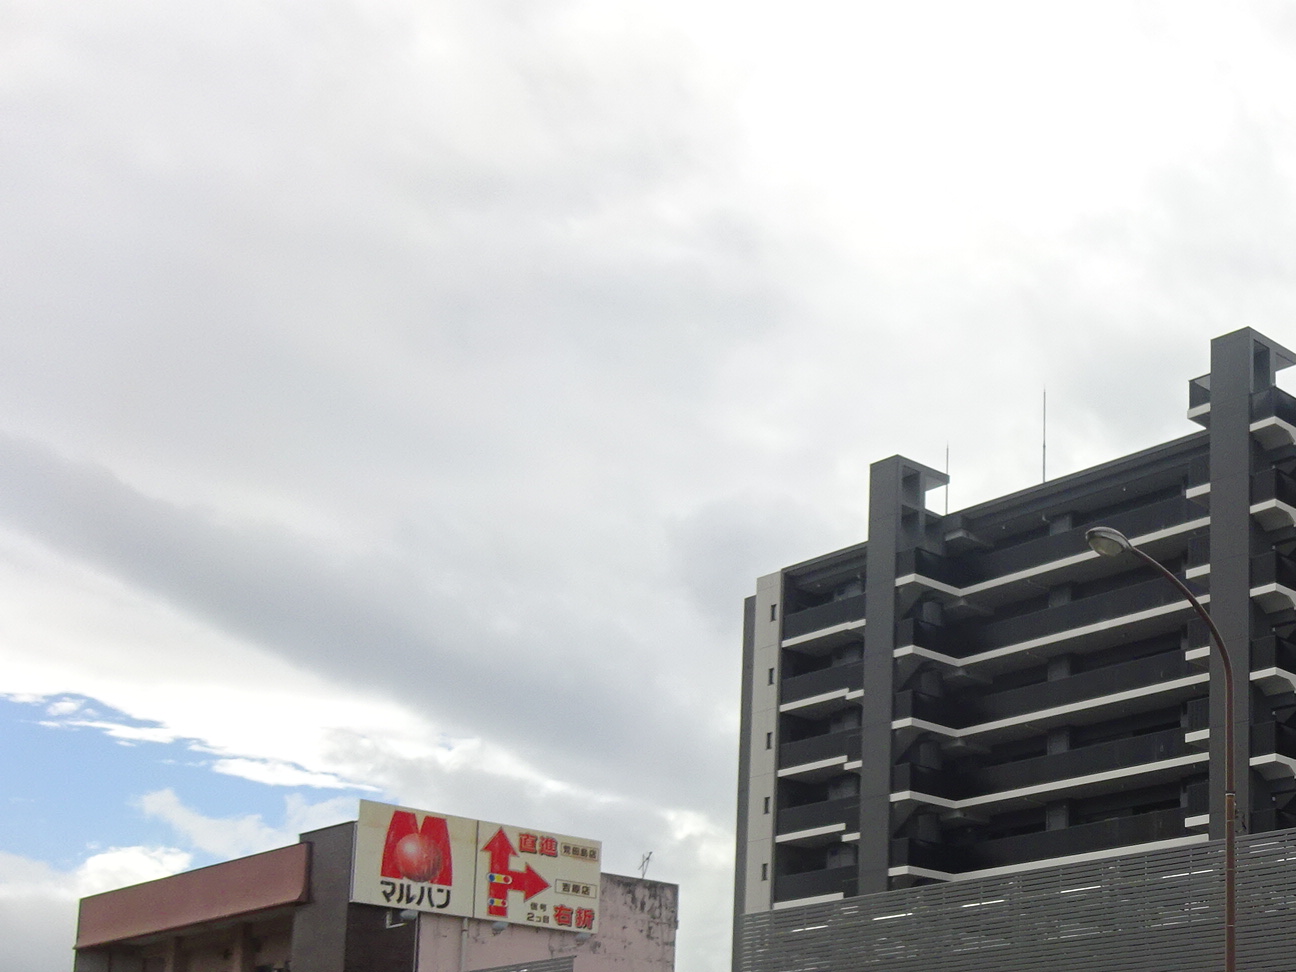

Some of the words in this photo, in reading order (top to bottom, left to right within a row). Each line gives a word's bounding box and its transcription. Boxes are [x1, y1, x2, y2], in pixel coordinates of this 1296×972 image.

[519, 833, 558, 858] 直進
[380, 880, 452, 909] マルハン
[553, 904, 595, 930] 右折
